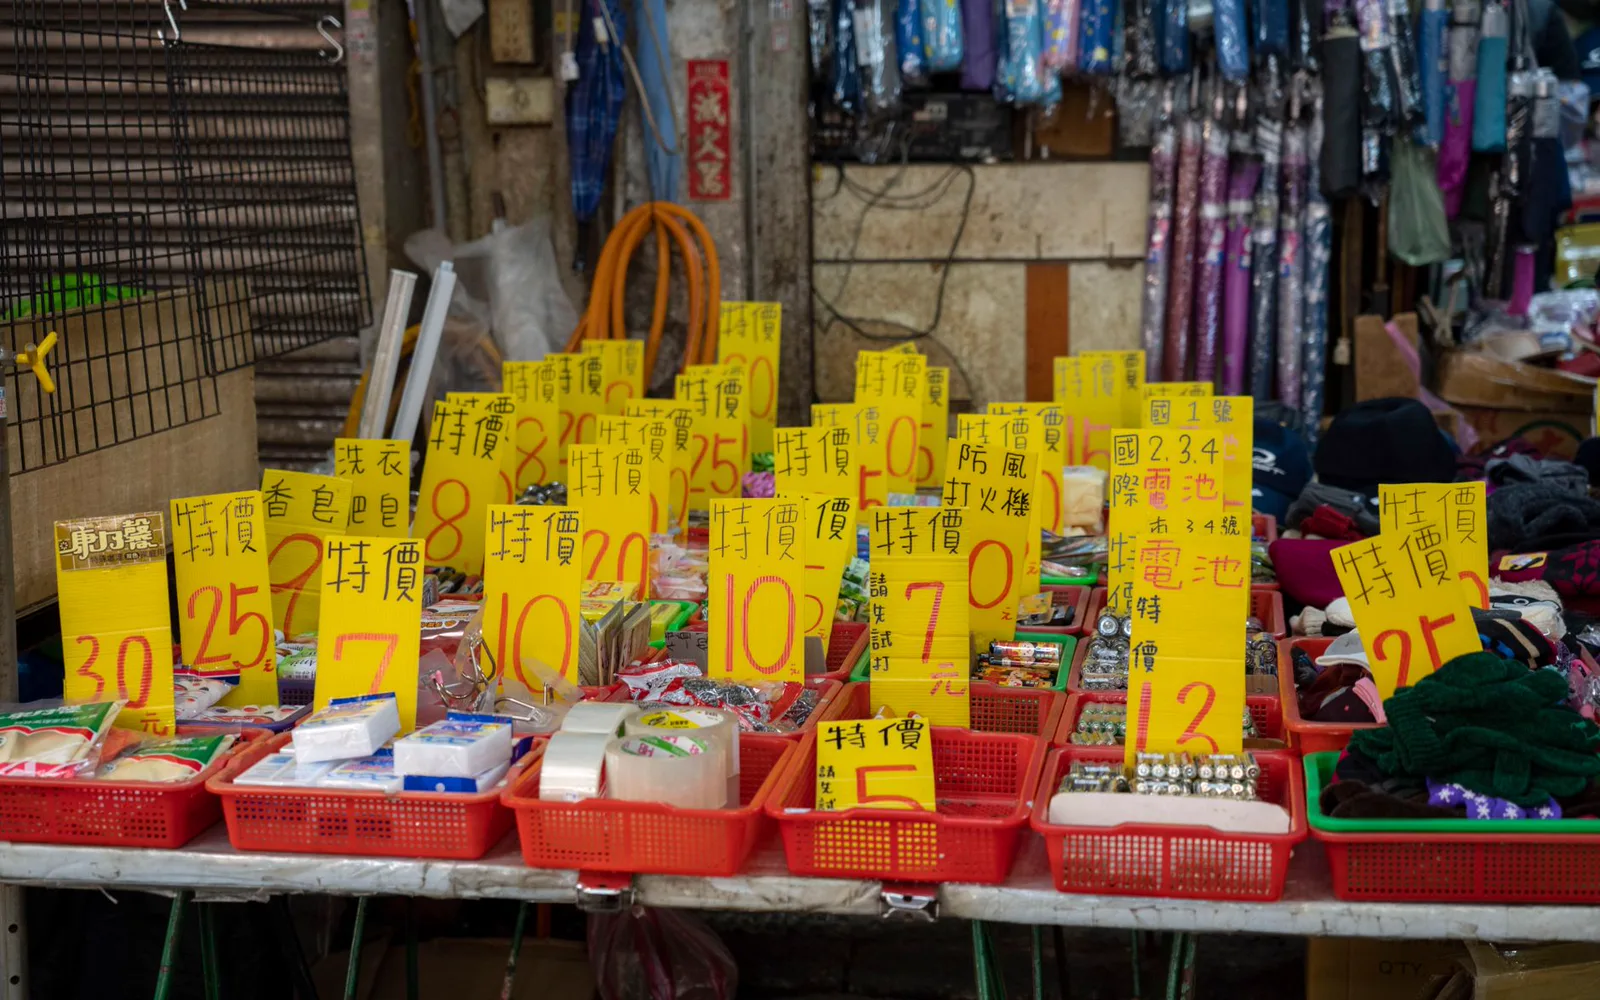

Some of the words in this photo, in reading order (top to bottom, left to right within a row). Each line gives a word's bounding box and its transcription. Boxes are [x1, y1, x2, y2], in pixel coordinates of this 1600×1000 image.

[504, 363, 556, 403] 特價
[859, 356, 921, 398] 特價
[337, 443, 403, 476] 洗衣
[431, 404, 504, 460] 特價
[777, 427, 850, 477] 特價
[571, 447, 643, 498] 特價
[958, 443, 1027, 479] 防風
[1143, 468, 1218, 510] 電池
[263, 478, 339, 524] 香皂
[425, 479, 470, 563] 8
[944, 477, 1030, 517] 打火機
[1383, 485, 1477, 544] 特價
[176, 495, 258, 562] 特價
[490, 509, 580, 567] 特價
[712, 502, 800, 561] 特價
[876, 508, 963, 556] 特價
[268, 533, 324, 642] 9
[327, 540, 421, 603] 特價
[1140, 540, 1245, 591] 電池
[1338, 524, 1452, 606] 特價
[187, 582, 270, 670] 25
[497, 591, 572, 693] 10
[726, 573, 796, 675] 10
[905, 581, 945, 664] 7
[1133, 594, 1162, 673] 特價
[76, 635, 153, 709] 30
[333, 632, 399, 695] 7
[930, 662, 969, 697] 元
[824, 718, 925, 751] 特價
[855, 764, 926, 812] 5
